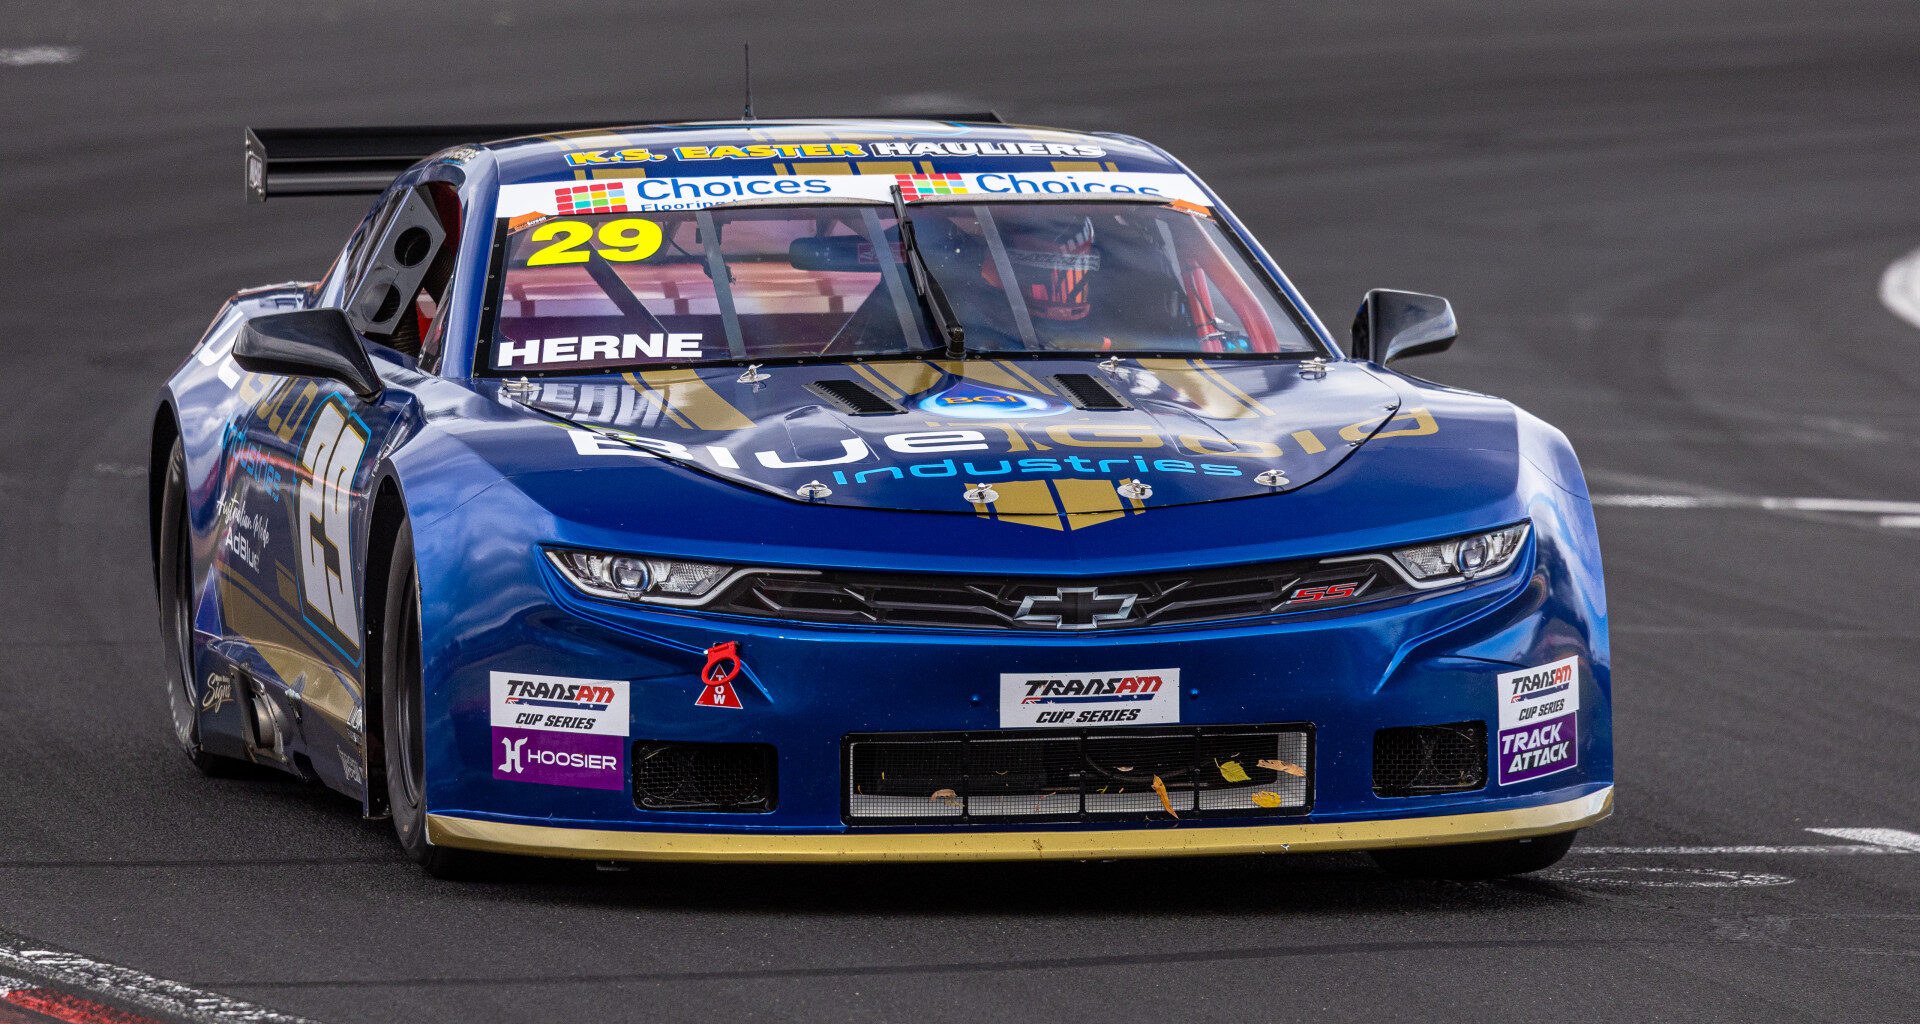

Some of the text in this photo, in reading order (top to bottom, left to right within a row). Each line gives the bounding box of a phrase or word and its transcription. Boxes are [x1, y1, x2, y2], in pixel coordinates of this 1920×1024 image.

[564, 142, 1106, 167] K.S. EASTER HAULIERS
[637, 175, 832, 201] Choices
[526, 218, 663, 267] 29
[498, 333, 703, 367] HERNE
[1286, 582, 1358, 605] SS
[713, 674, 726, 705] TOW
[515, 712, 597, 730] CUP SERIES
[1036, 708, 1142, 724] CUP SERIES
[1518, 698, 1565, 721] CUP SERIES
[1502, 722, 1563, 755] TRACK
[528, 749, 617, 771] HOOSIER
[1508, 741, 1570, 774] ATTACK
